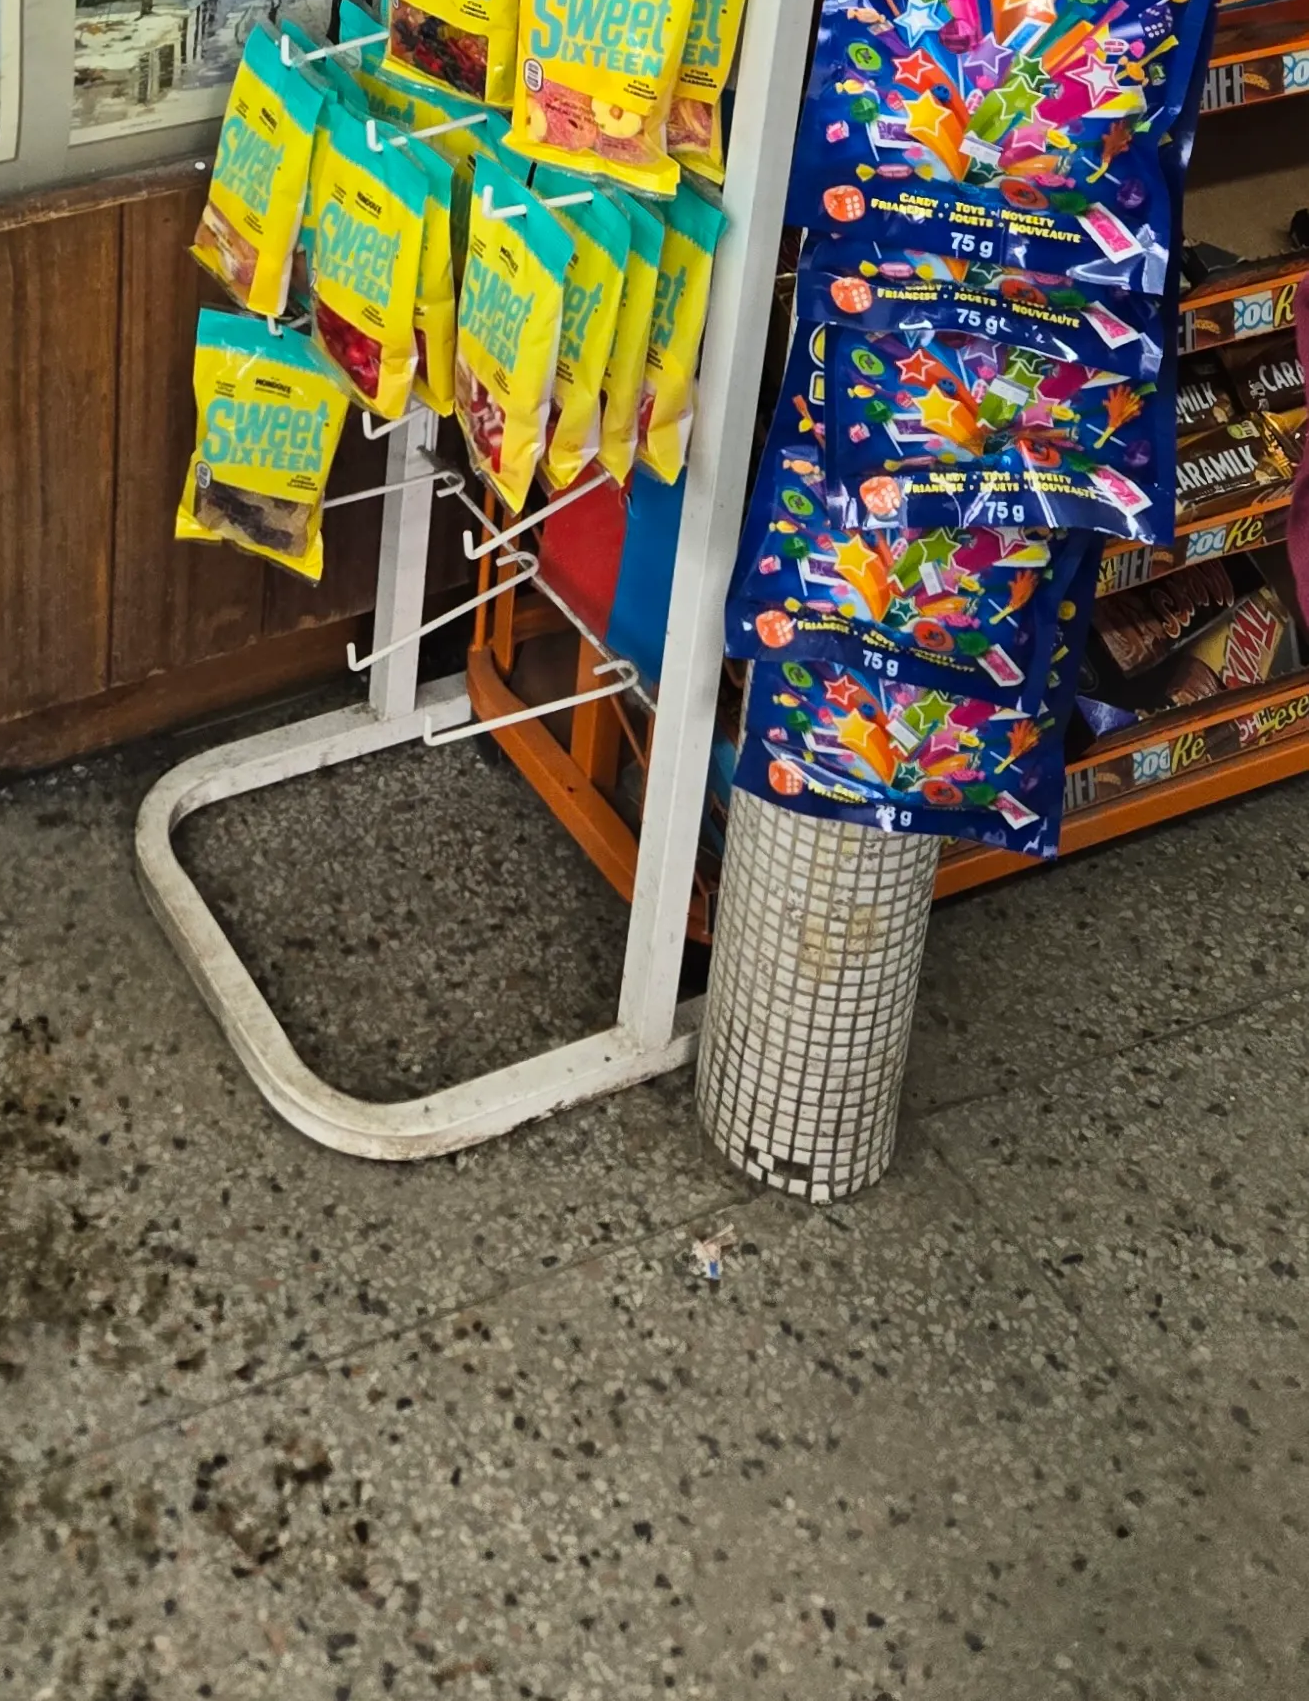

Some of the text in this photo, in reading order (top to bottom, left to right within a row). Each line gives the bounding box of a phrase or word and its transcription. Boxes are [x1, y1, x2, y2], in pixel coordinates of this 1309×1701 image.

[871, 198, 933, 219] FRIANDISE
[949, 213, 993, 228] JOUETS
[900, 192, 1054, 227] CANDY TOYS NOVELTY
[951, 232, 993, 258] 75 g
[954, 292, 997, 307] JOUETS
[957, 308, 998, 335] 75 g
[930, 472, 967, 483] CANDY
[986, 502, 1025, 522] 75 g
[863, 650, 899, 677] 75 g
